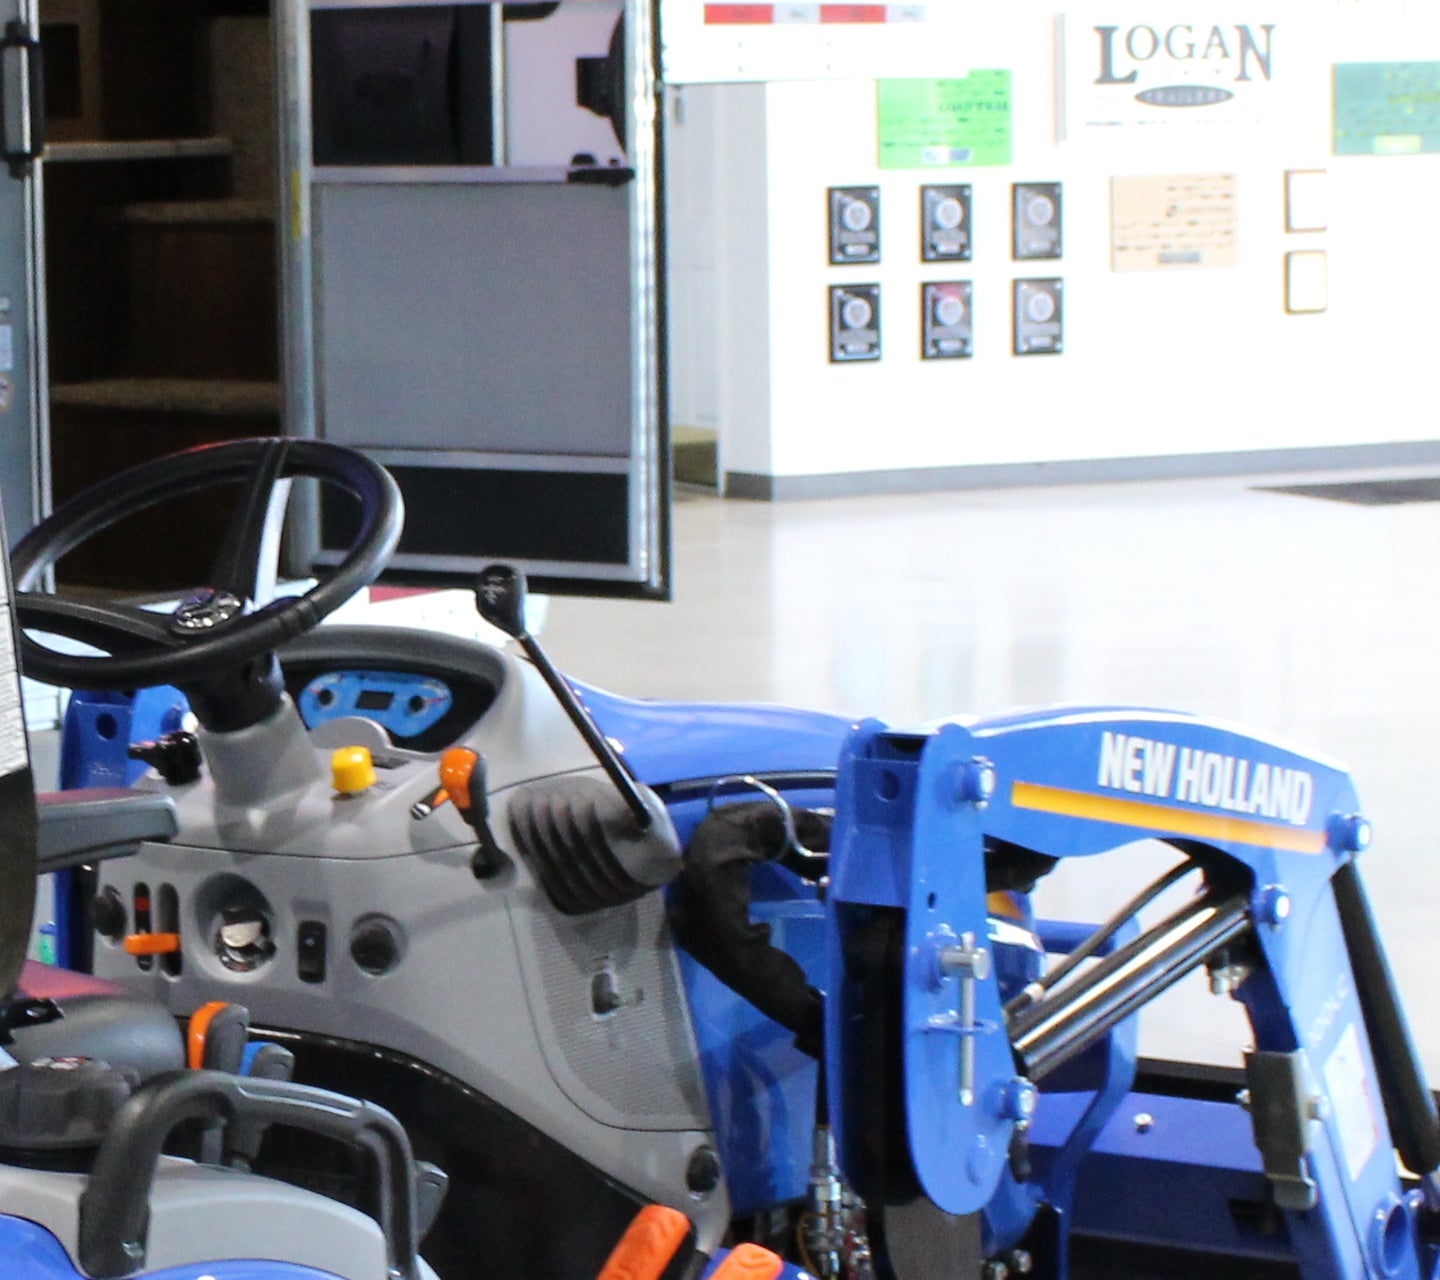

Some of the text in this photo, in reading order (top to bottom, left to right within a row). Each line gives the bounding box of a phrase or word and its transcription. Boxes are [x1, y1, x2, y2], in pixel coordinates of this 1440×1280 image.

[1092, 23, 1277, 85] LOGAN
[1097, 730, 1314, 826] NEW HOLLAND
